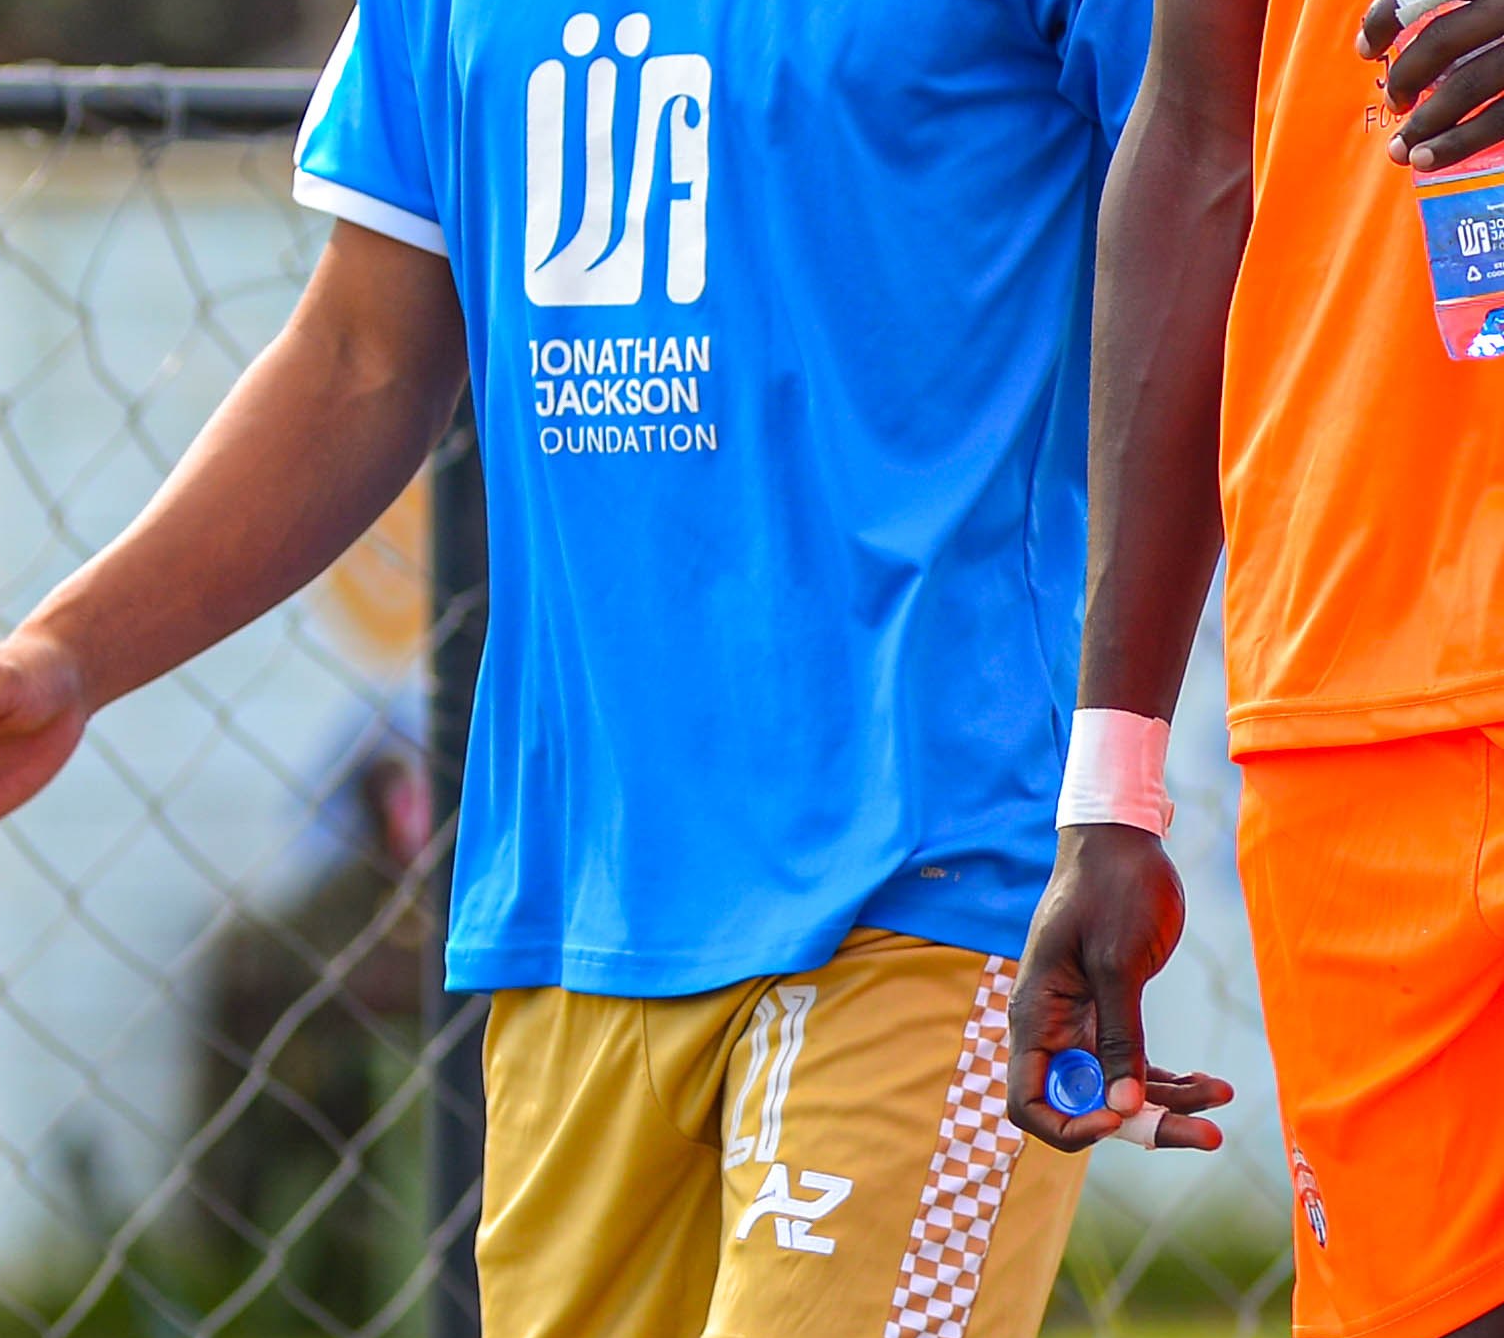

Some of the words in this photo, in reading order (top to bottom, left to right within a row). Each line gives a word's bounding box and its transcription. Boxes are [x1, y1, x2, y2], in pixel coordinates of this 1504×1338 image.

[529, 336, 710, 377] JONATHAN
[535, 377, 699, 417] JACKSON
[540, 423, 718, 455] OUNDATION
